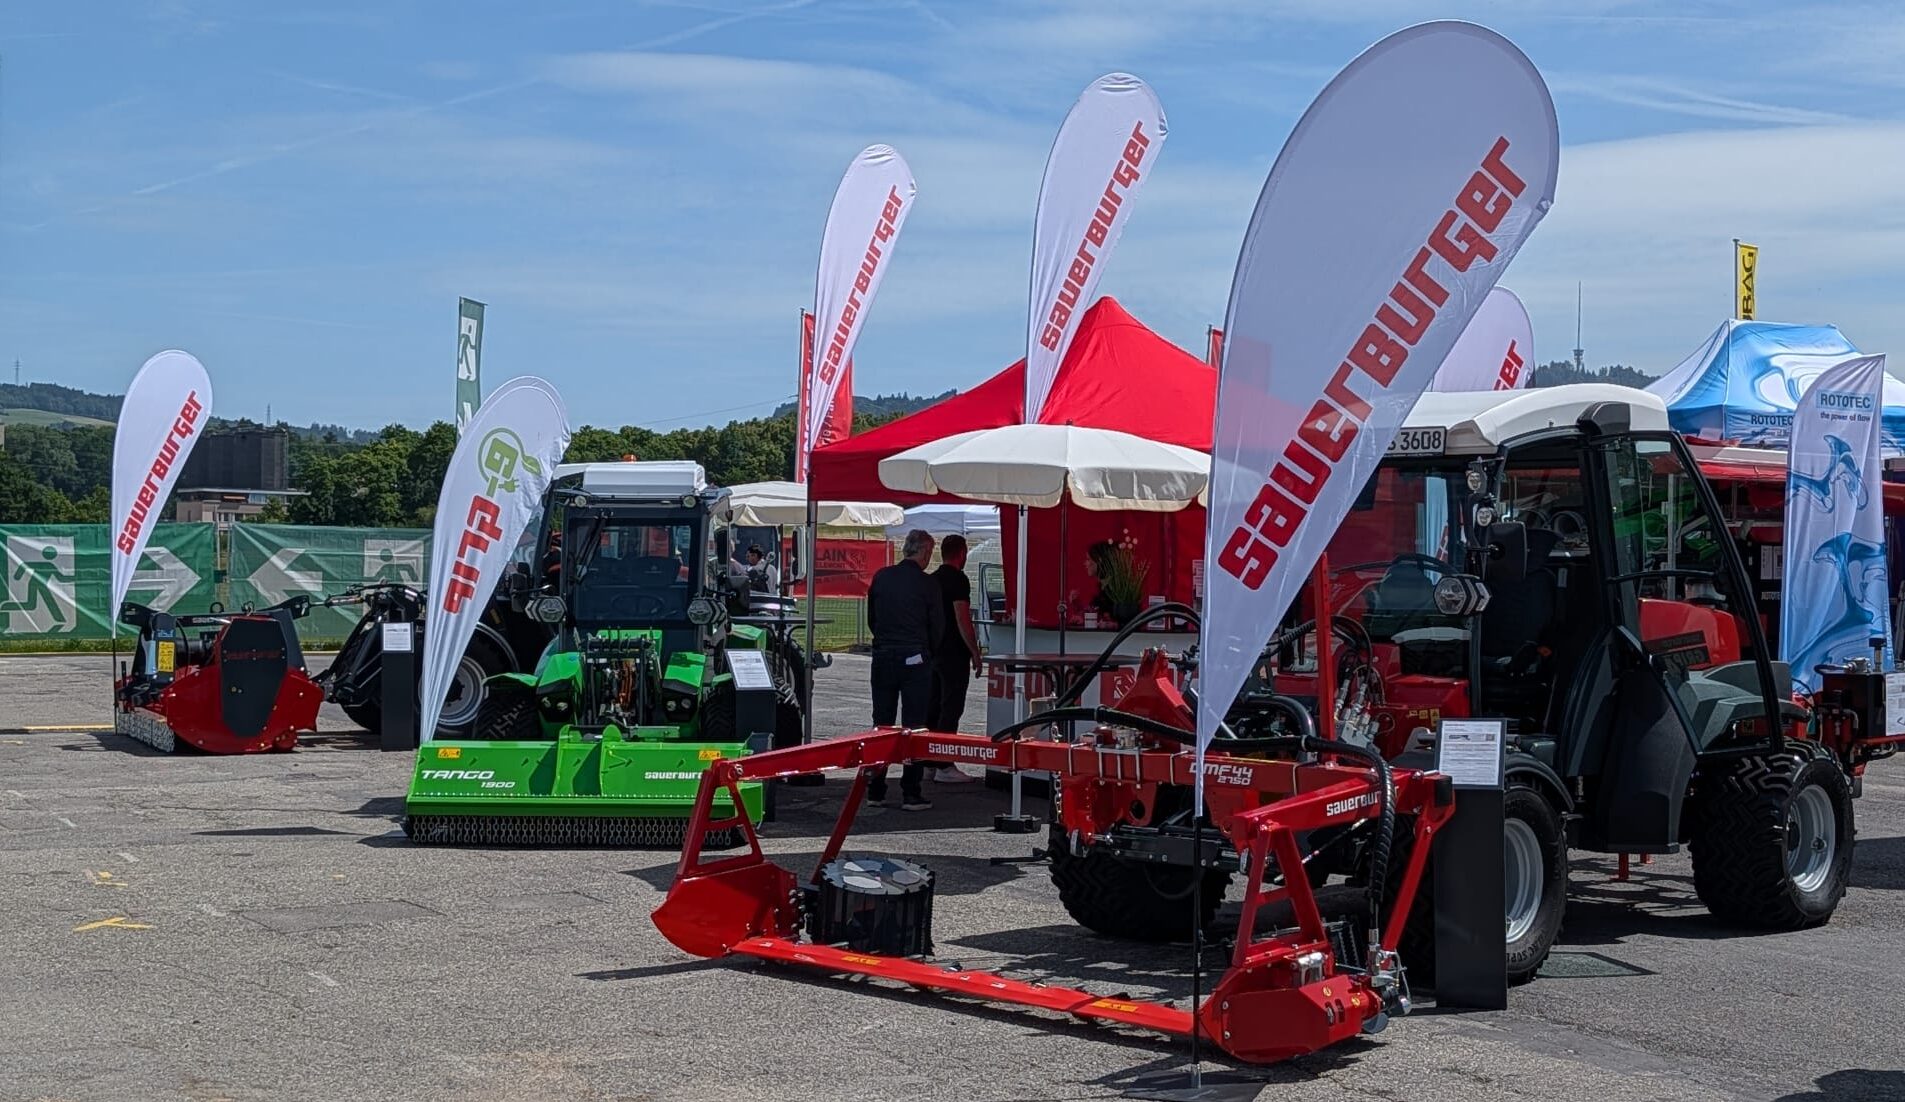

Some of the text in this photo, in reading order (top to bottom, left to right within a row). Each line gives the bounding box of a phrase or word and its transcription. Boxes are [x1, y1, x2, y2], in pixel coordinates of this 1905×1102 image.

[1820, 393, 1871, 409] ROTOTEC
[1399, 430, 1442, 451] 3608
[421, 769, 495, 780] TANGO
[1217, 775, 1251, 786] 2750
